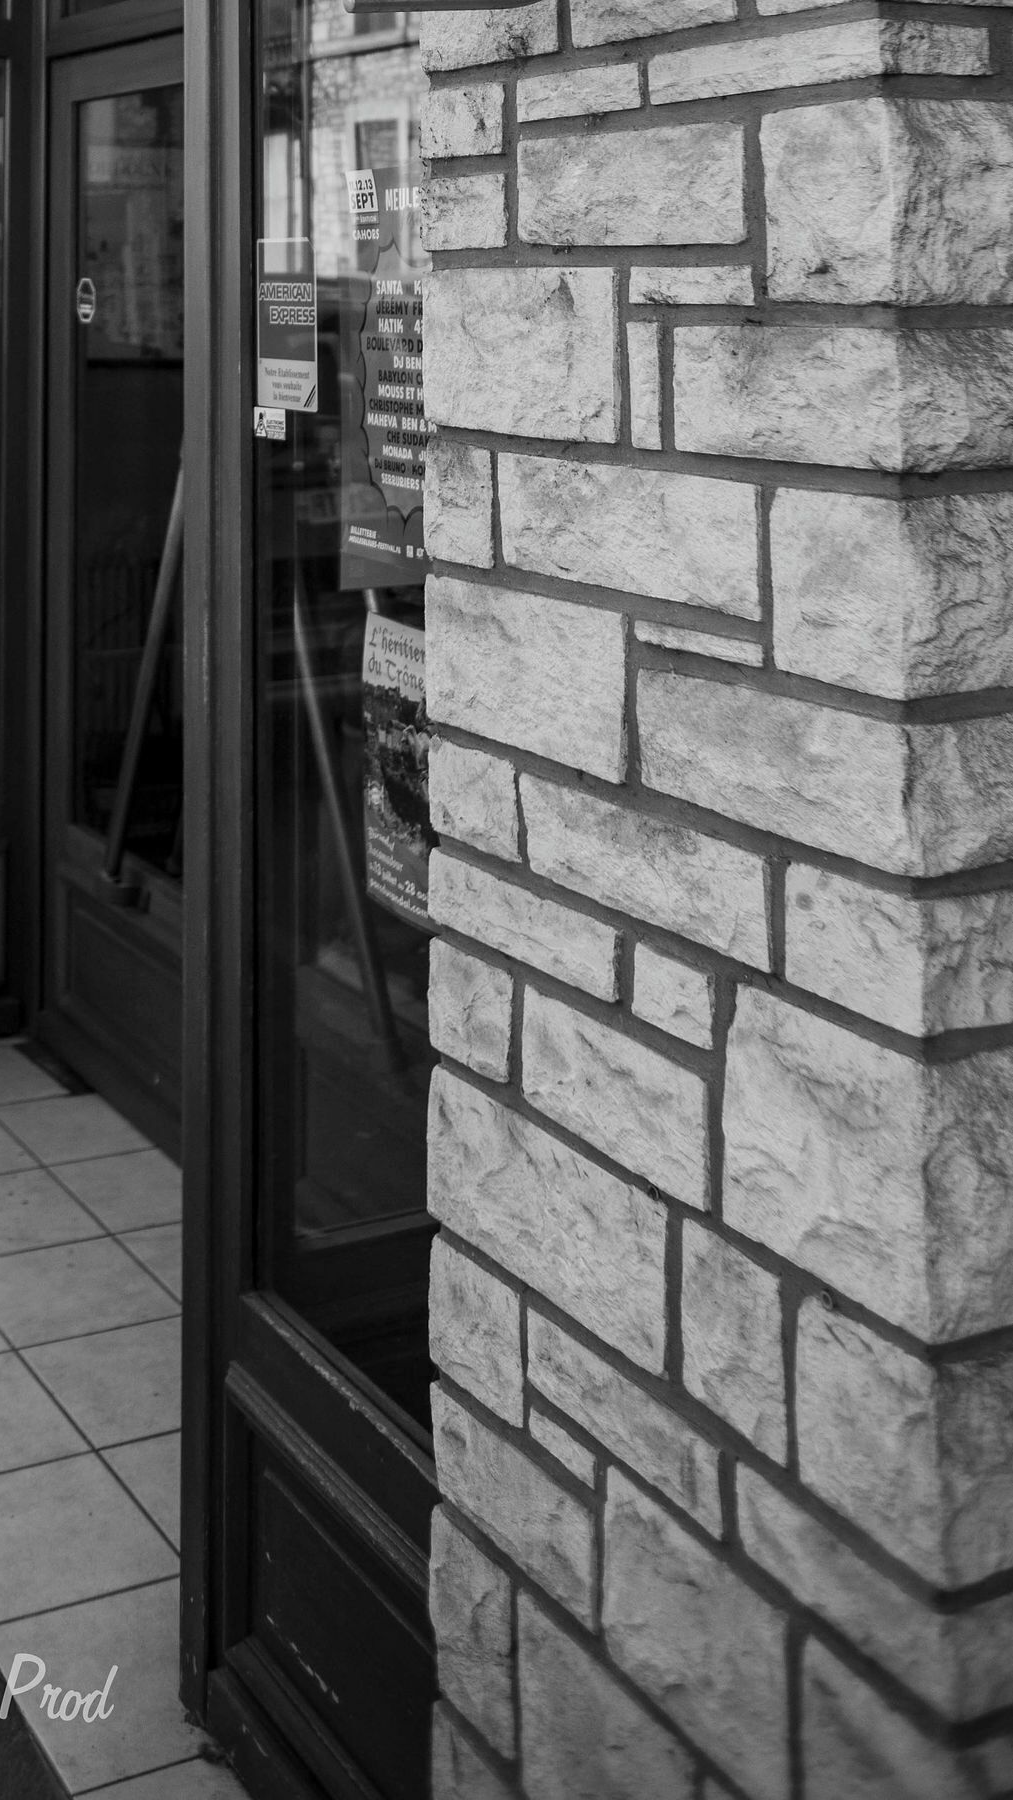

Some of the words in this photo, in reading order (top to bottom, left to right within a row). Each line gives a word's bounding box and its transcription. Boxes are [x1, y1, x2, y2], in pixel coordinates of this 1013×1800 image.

[350, 192, 374, 210] SEPT
[352, 228, 380, 241] CAHORS
[258, 283, 312, 301] AMERICAN
[376, 279, 403, 295] SANTA
[376, 294, 410, 316] JÉRÉMY
[270, 305, 316, 325] EXPRESS
[379, 317, 404, 334] HATIK
[366, 336, 414, 353] BOULEVARD
[394, 355, 404, 369] DJ
[378, 368, 414, 385] BABYLON
[378, 383, 405, 400] MOUSS
[406, 386, 416, 401] ET
[369, 397, 414, 415] CHRISTOPHE
[368, 412, 398, 429] MAHEVA
[419, 418, 427, 433] &
[387, 430, 400, 445] CHE
[374, 457, 383, 470] DJ
[384, 459, 406, 474] BRUNO
[368, 652, 382, 676] du
[405, 879, 416, 897] 28
